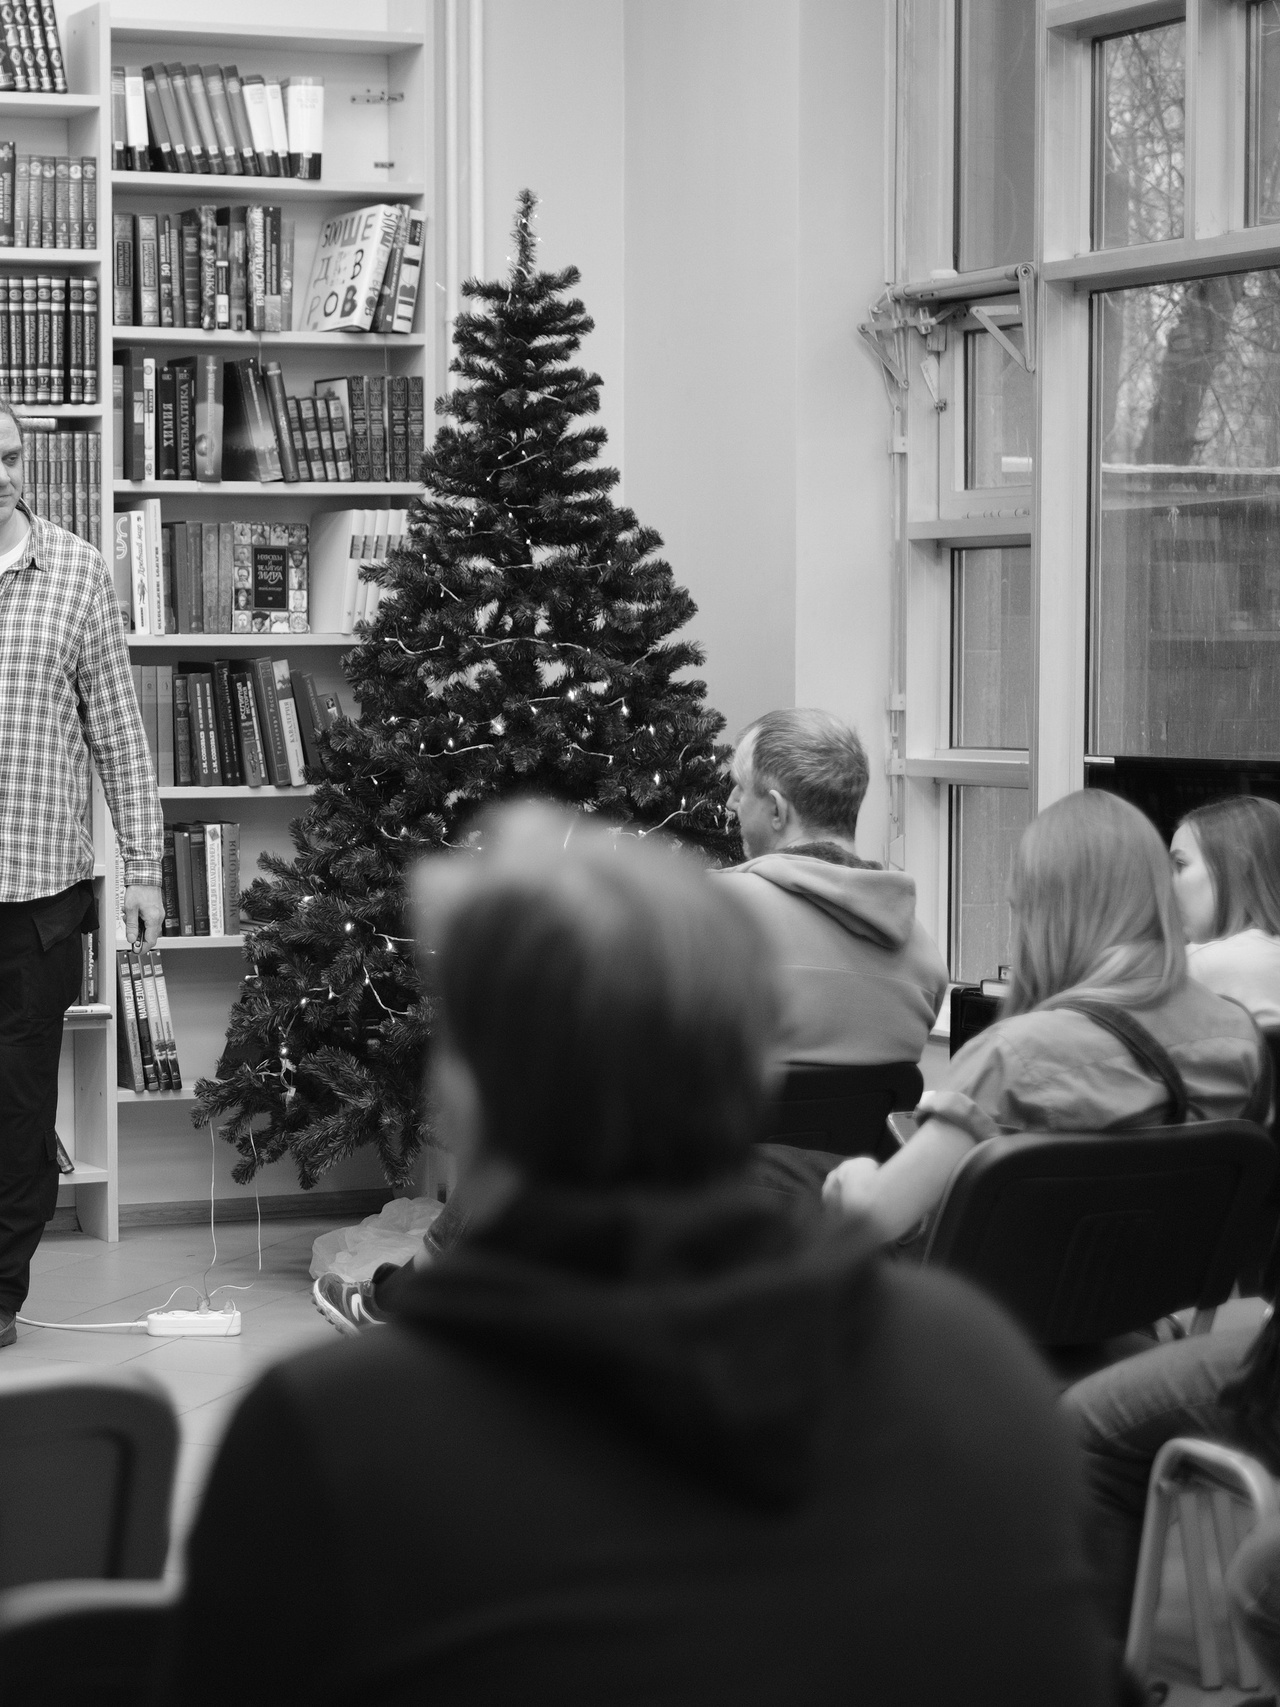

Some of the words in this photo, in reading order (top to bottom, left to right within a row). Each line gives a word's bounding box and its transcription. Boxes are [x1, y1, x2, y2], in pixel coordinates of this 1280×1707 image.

[20, 220, 25, 230] 1
[32, 220, 39, 230] 2
[46, 222, 53, 232] 3
[60, 222, 67, 232] 4
[73, 223, 80, 232] 5
[87, 222, 94, 232] 6
[253, 206, 264, 257] КАЛИНИН
[321, 220, 343, 248] 500
[117, 242, 125, 286] ПУШКИНСКАЯ
[161, 263, 171, 277] 50
[204, 249, 215, 296] МУЗЫКА
[255, 257, 265, 306] ВЯЧЕСЛАВ
[306, 283, 358, 326] РОВ
[0, 377, 9, 385] 14
[13, 377, 22, 385] 15
[27, 377, 36, 385] 16
[39, 376, 49, 384] 17
[73, 377, 81, 385] 19
[85, 378, 96, 386] 20
[162, 403, 174, 448] ХИМИЯ
[180, 383, 190, 466] МАТЕМАТИКА
[257, 553, 283, 561] НАРОДЫ
[257, 571, 283, 585] МИРА
[236, 681, 247, 720] ВСЕМИРНАЯ
[242, 686, 251, 714] ИСТОРИЯ
[283, 701, 295, 744] КАВАЛЕРИЯ
[228, 840, 237, 918] МИФОЛОГИЯ
[123, 980, 136, 1019] НАМЕДНИ
[134, 979, 148, 1019] НАМЕДНИ
[145, 979, 158, 1018] НАМЕДНИ
[155, 979, 169, 1017] НАМЕДНИ
